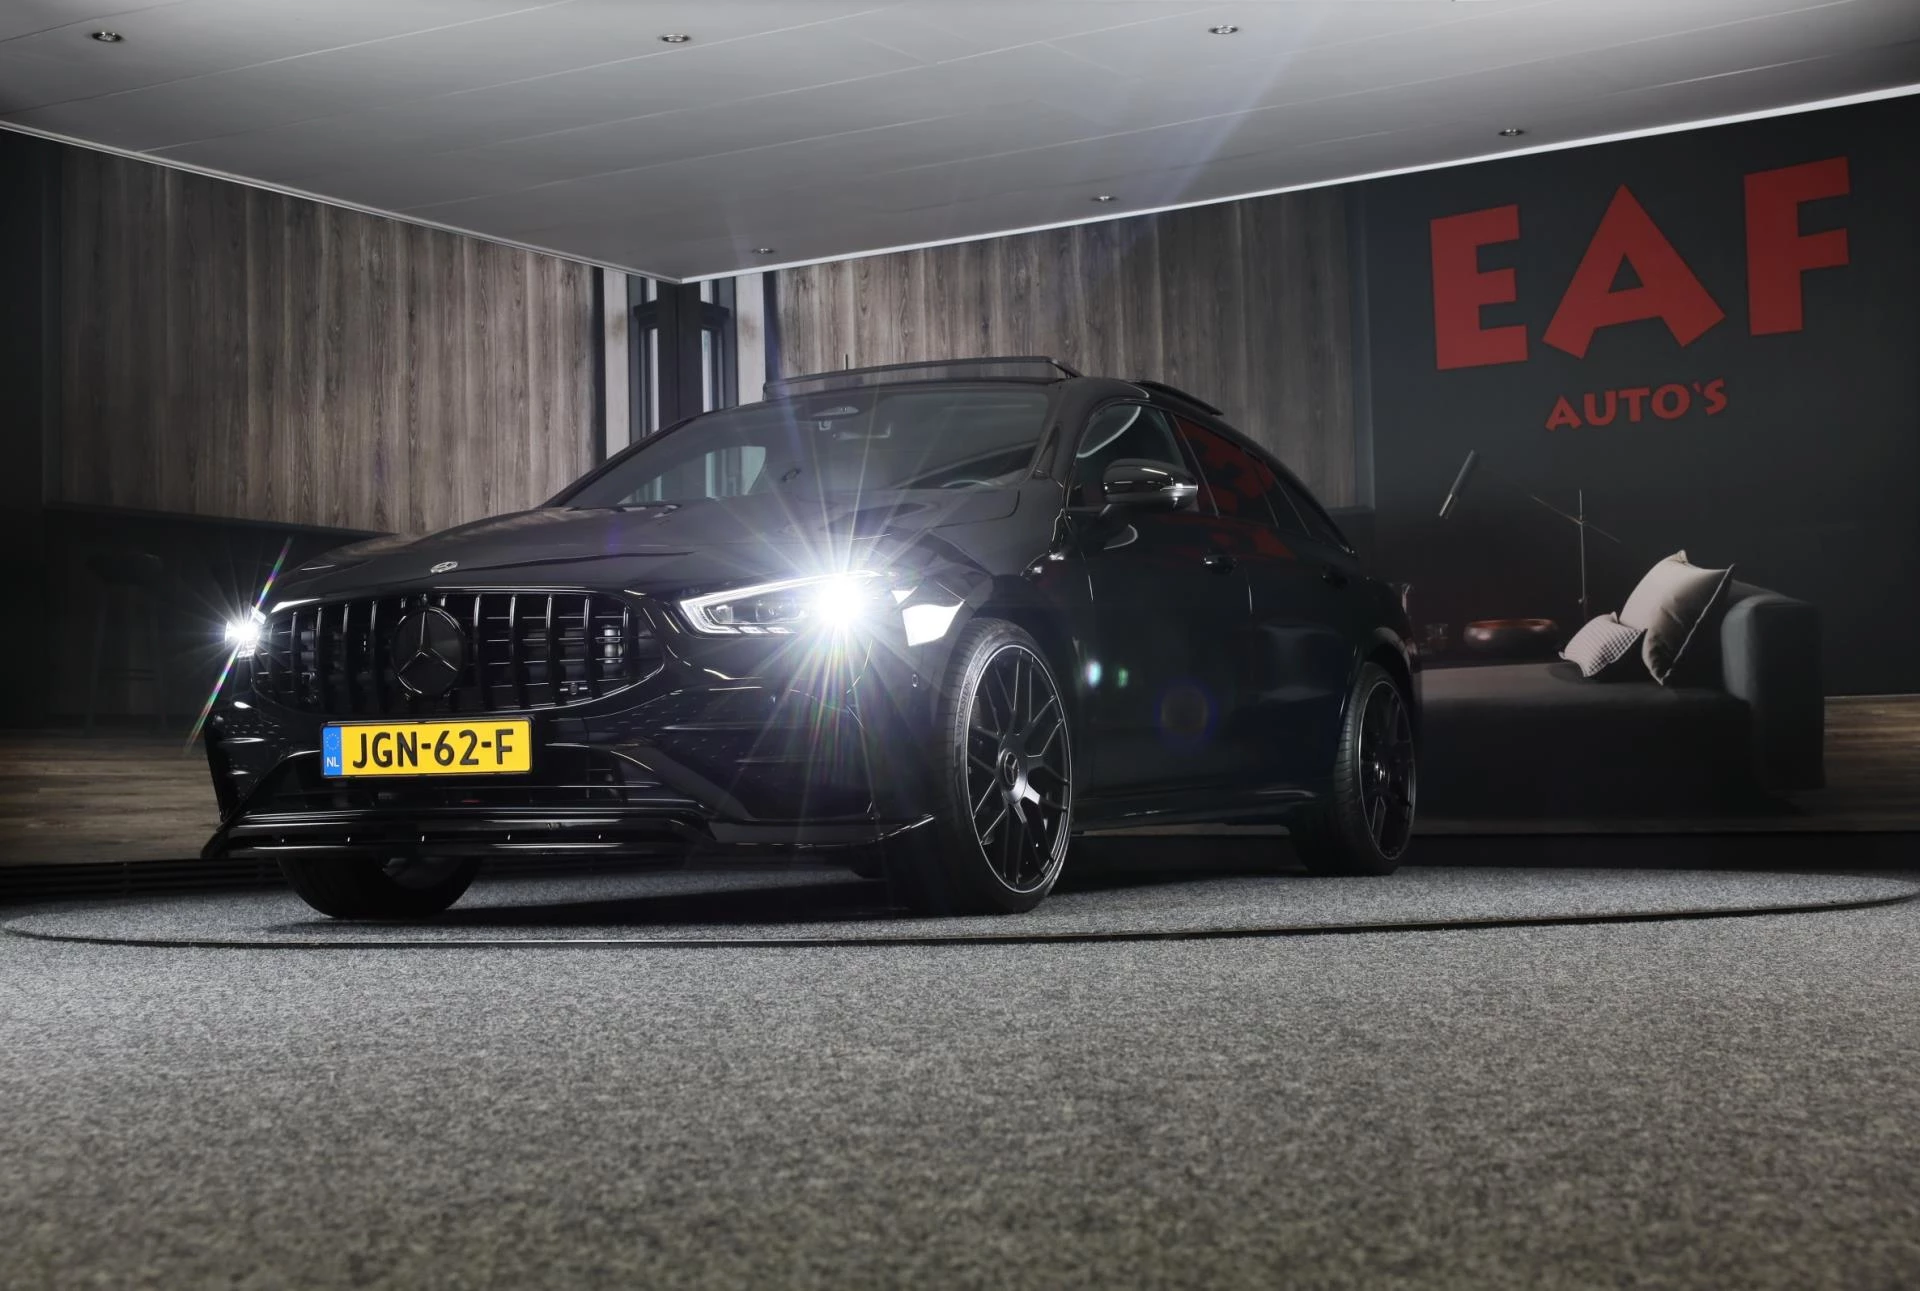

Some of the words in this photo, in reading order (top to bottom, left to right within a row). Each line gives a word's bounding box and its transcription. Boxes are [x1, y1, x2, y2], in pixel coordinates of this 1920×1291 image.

[1430, 156, 1850, 370] EAF
[1545, 378, 1728, 431] AUTO'S
[326, 757, 340, 768] NL
[352, 729, 514, 769] JGN-62-F
